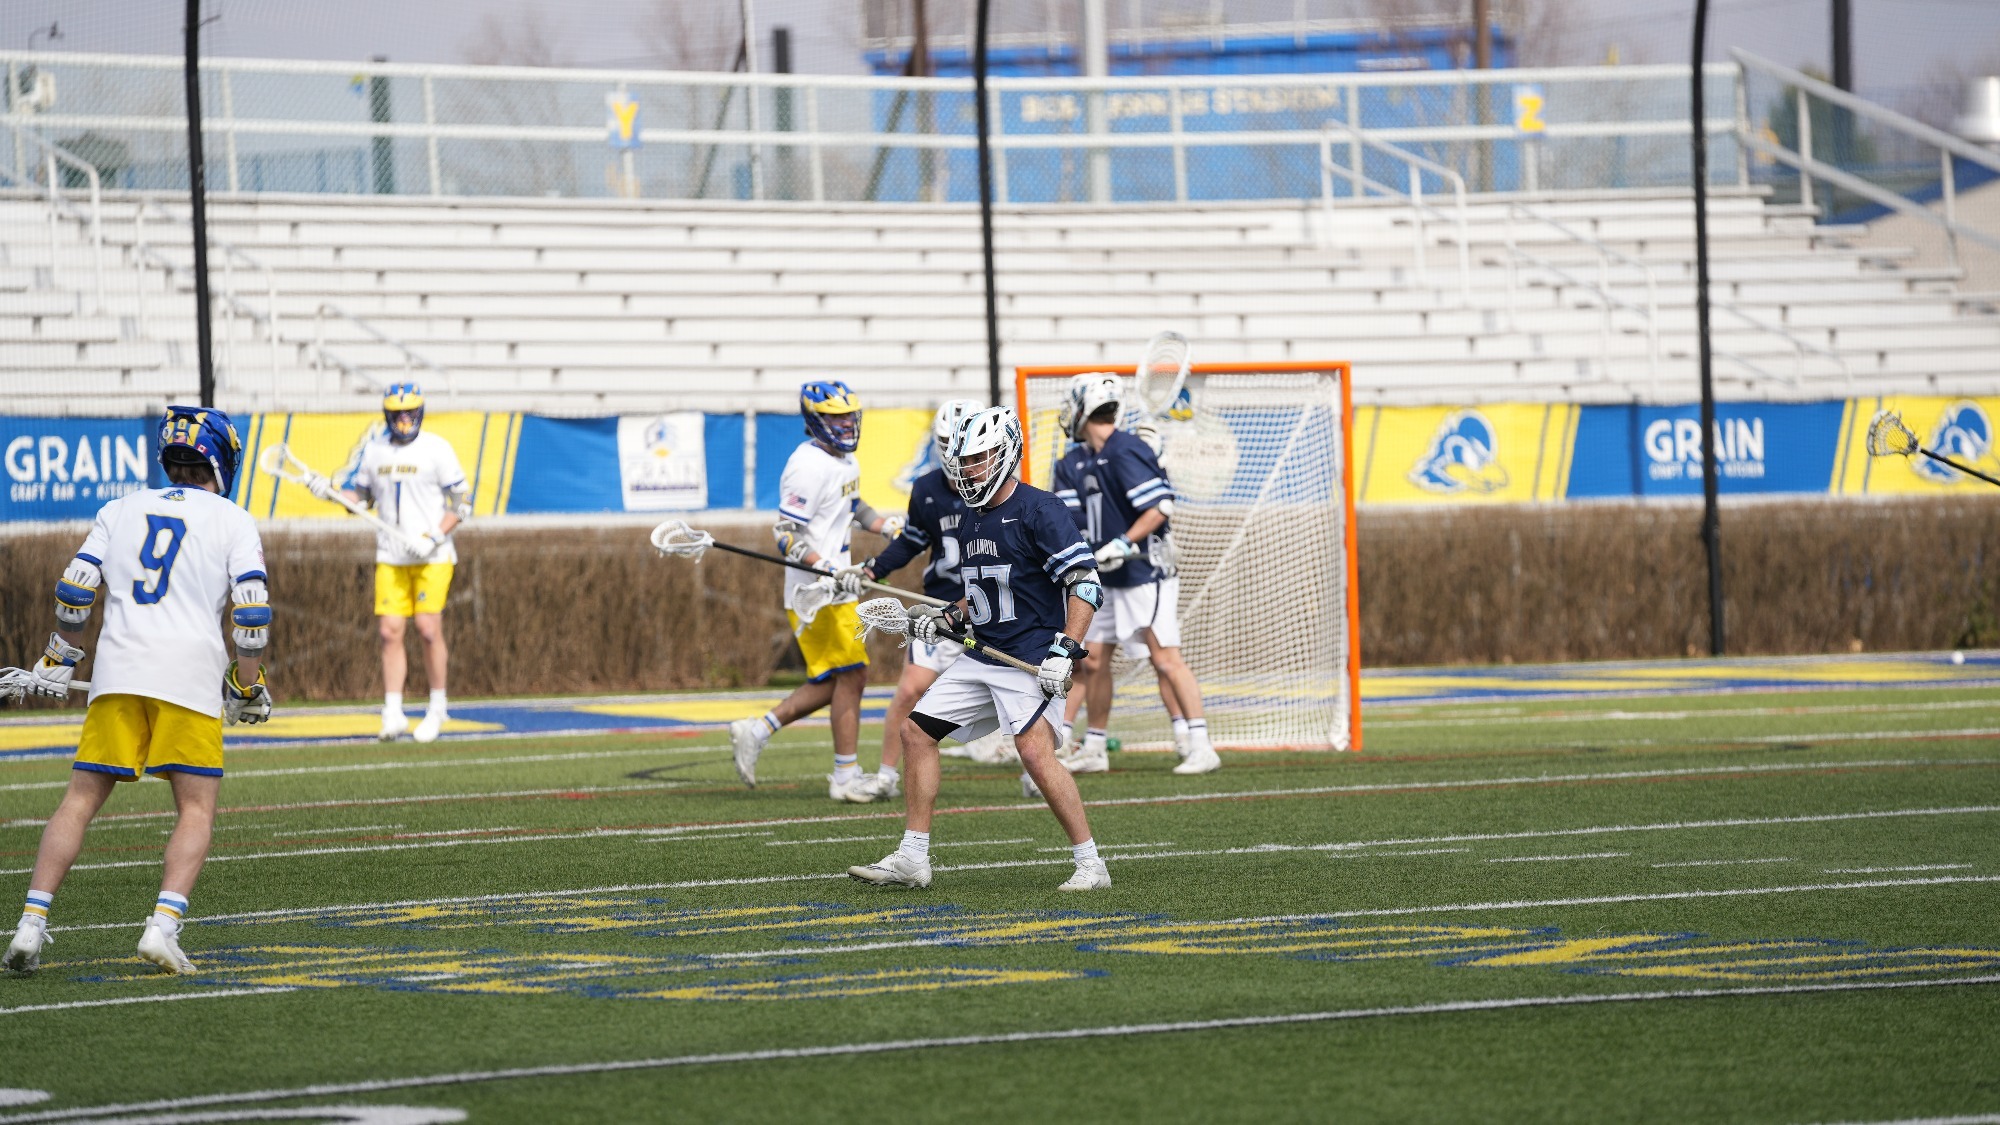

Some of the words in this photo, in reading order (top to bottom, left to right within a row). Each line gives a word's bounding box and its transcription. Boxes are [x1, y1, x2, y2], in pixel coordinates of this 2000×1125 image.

[4, 434, 148, 482] GRAIN
[132, 513, 187, 605] 9
[966, 539, 1000, 559] VILLANOVA
[961, 563, 1018, 625] 57
